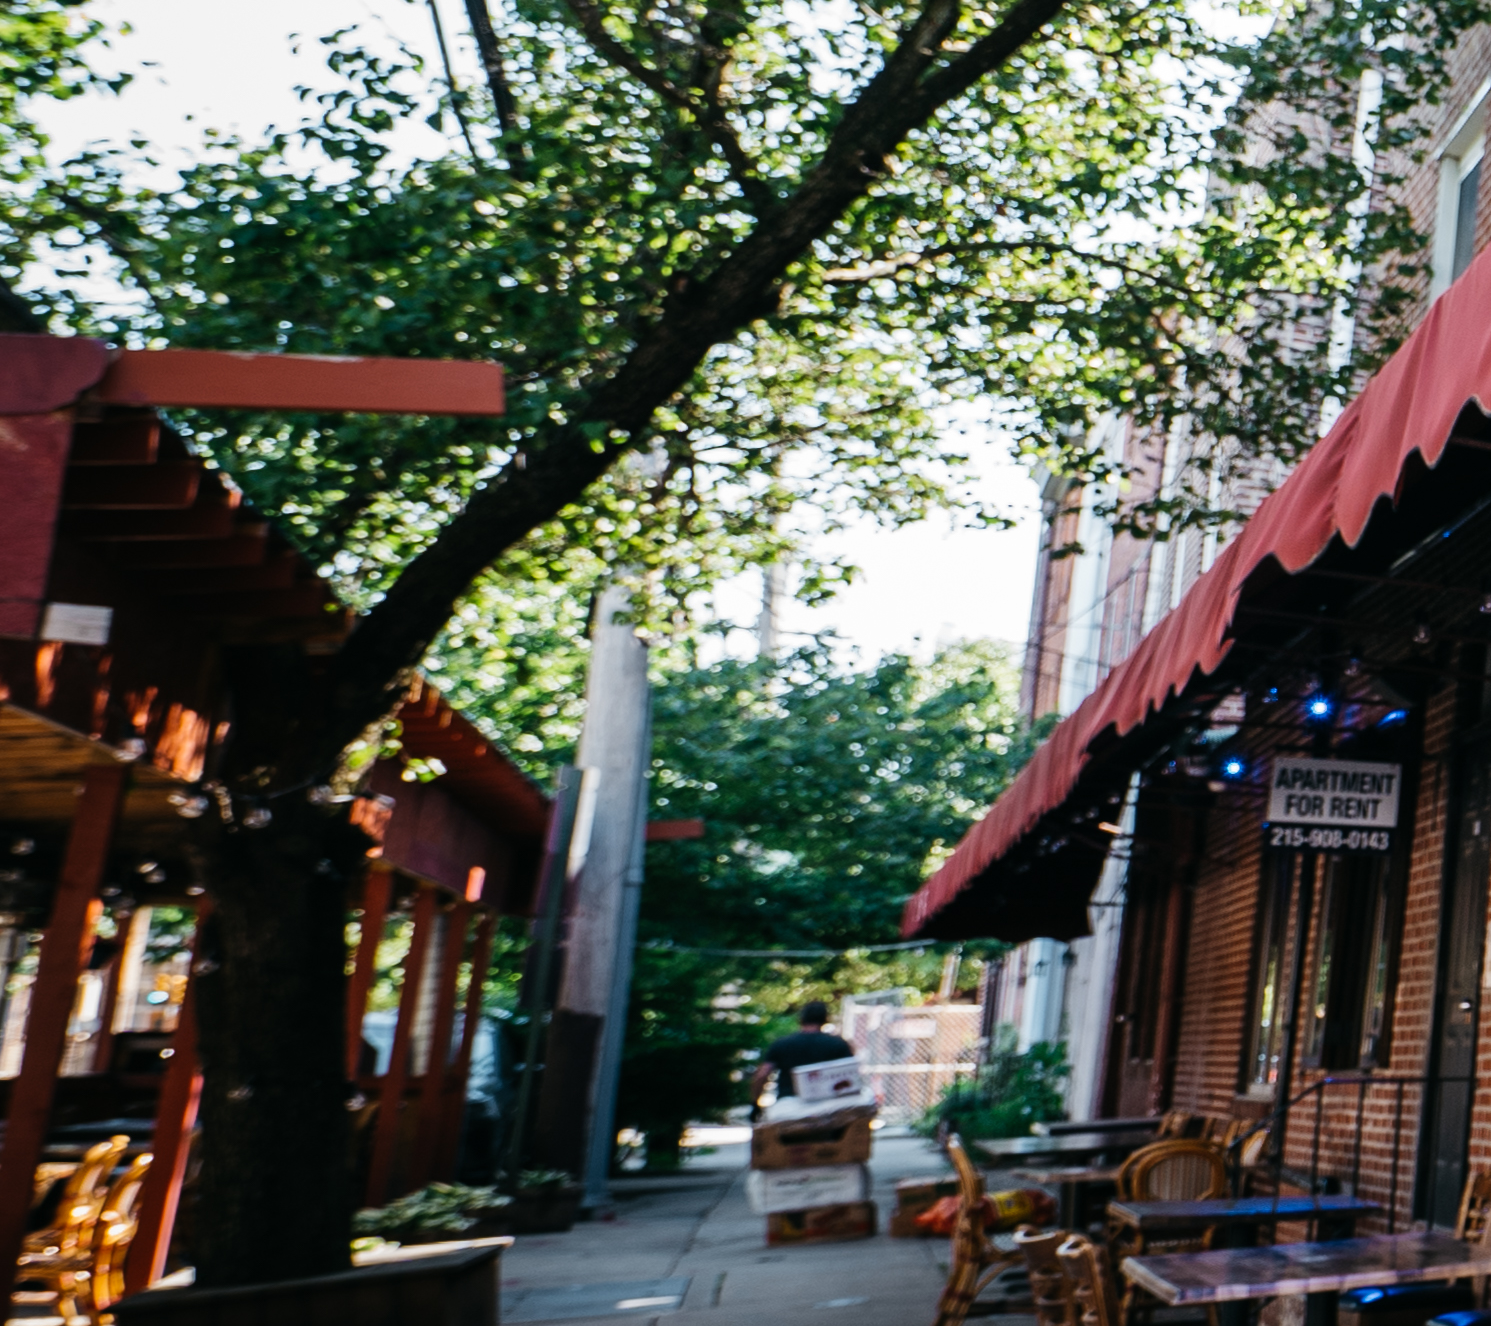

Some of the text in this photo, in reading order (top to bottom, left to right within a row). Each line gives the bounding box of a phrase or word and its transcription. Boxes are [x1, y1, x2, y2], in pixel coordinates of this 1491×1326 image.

[1275, 766, 1396, 796] APARTMENT
[1284, 794, 1382, 820] FOR RENT
